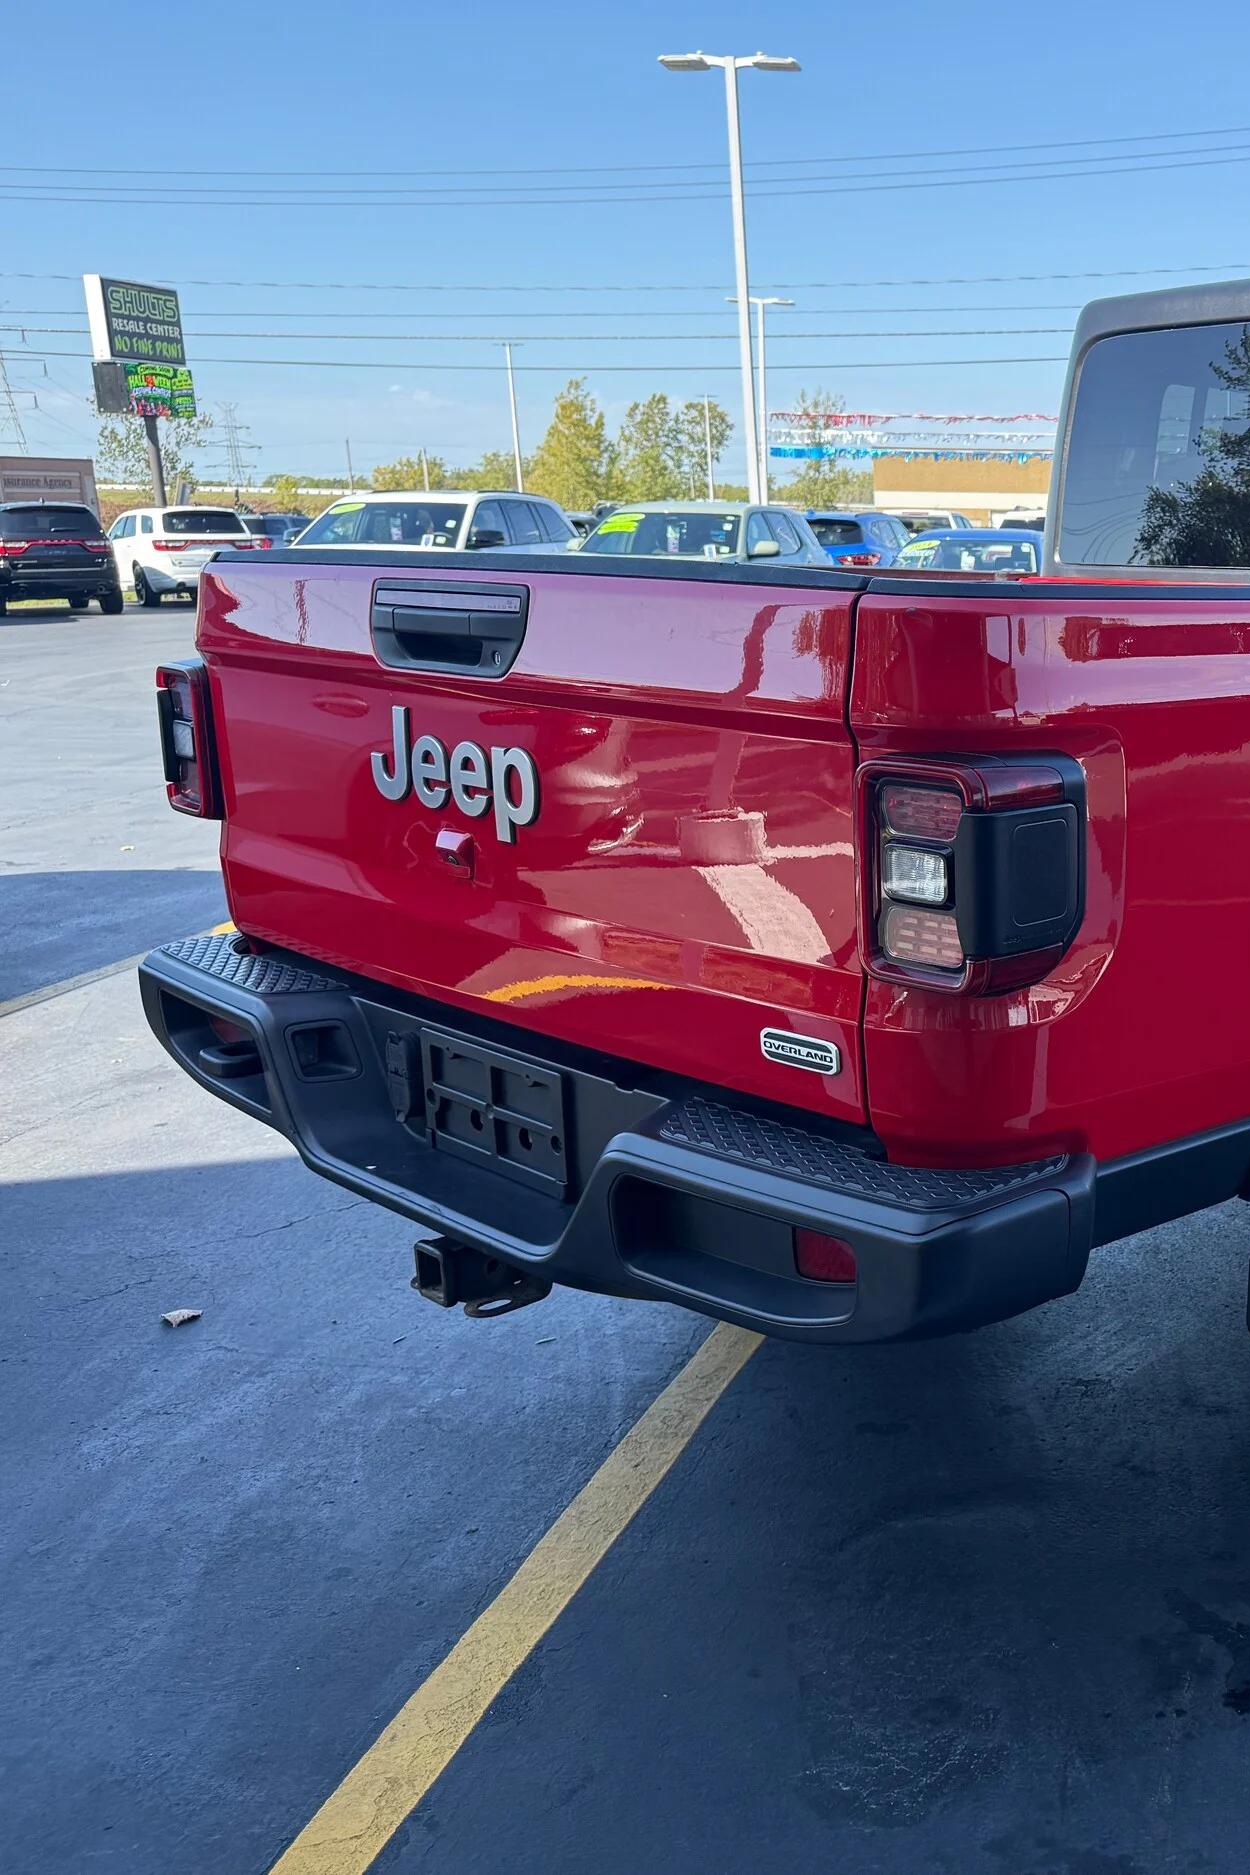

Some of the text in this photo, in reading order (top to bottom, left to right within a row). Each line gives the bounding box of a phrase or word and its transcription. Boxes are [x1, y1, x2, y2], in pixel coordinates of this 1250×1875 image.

[108, 287, 178, 322] SHULTS
[112, 317, 181, 339] RESALE CENTER
[114, 334, 182, 358] NO FINE PRINT
[44, 475, 72, 490] Agency
[371, 705, 541, 845] Jeep
[763, 1040, 834, 1064] OVERLAND
